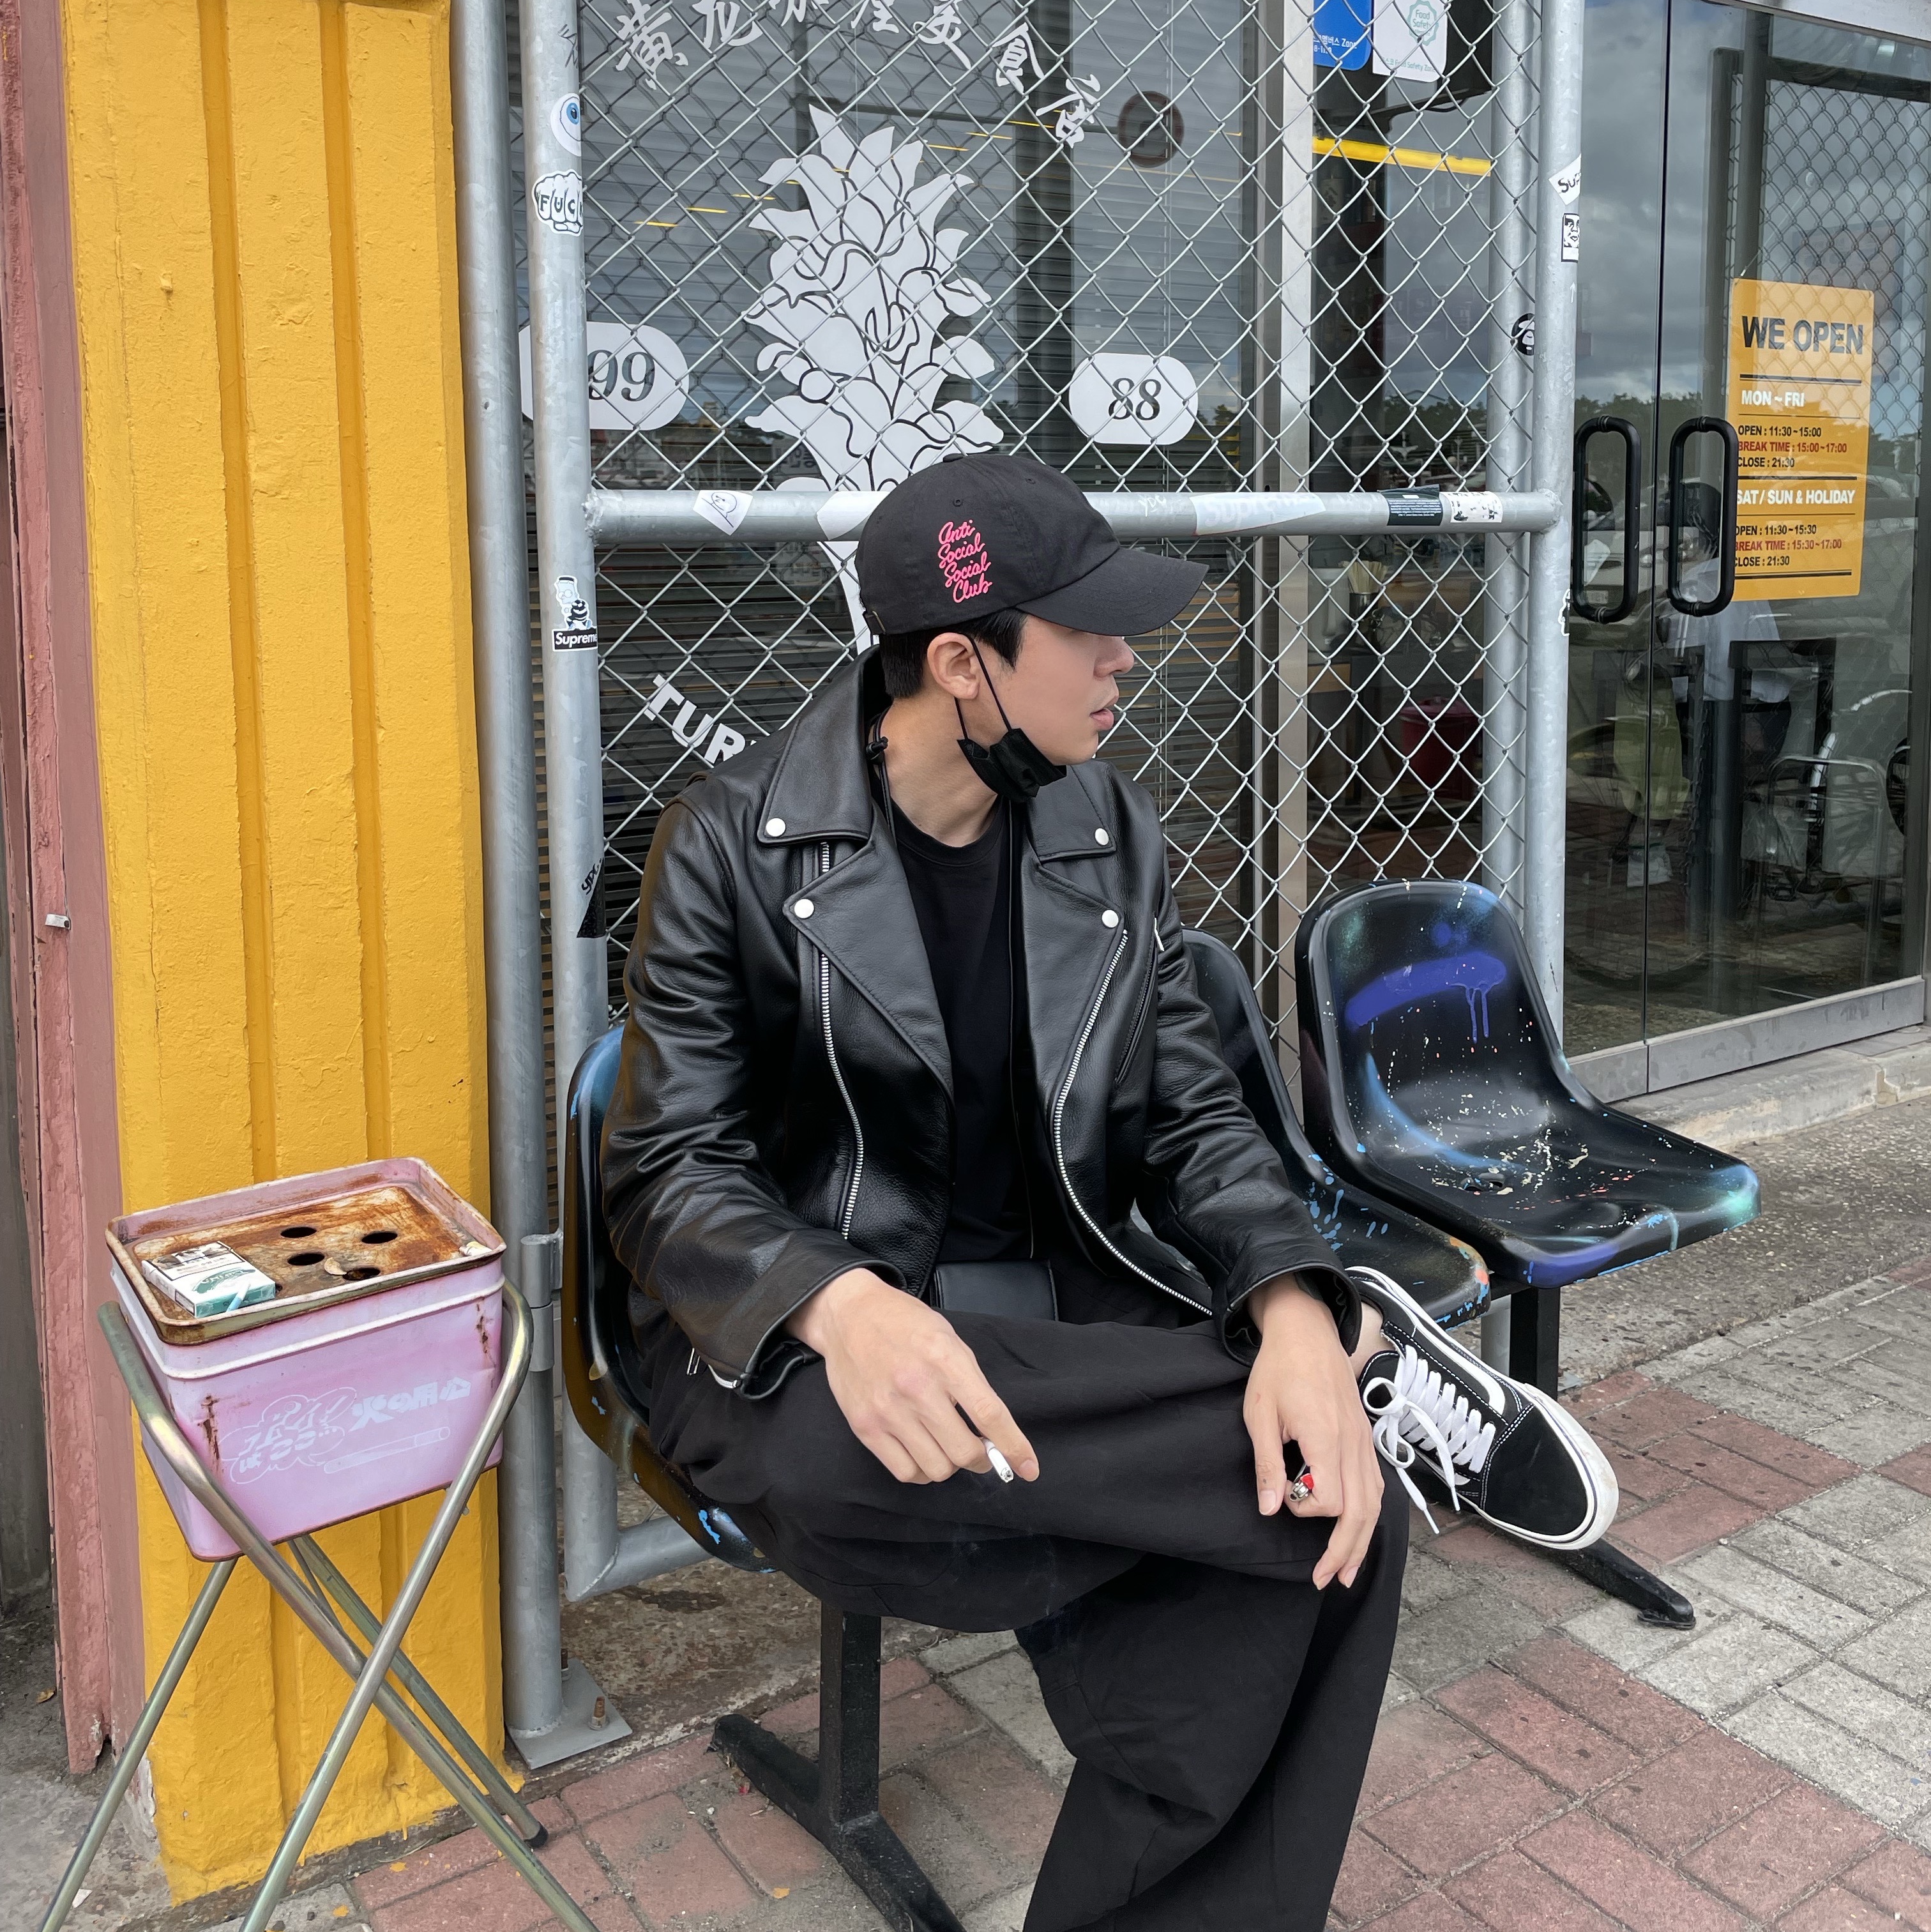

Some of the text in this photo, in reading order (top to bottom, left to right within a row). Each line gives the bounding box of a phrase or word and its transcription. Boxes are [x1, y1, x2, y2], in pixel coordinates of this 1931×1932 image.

[1415, 9, 1430, 20] Food
[1407, 61, 1423, 72] Safety
[1741, 316, 1864, 355] WE OPEN
[588, 349, 656, 401] 99
[1108, 377, 1162, 421] 88
[1741, 390, 1772, 406] MON
[1785, 391, 1805, 407] FRI
[1738, 425, 1762, 436] OPEN
[1738, 441, 1768, 452] BREAK
[1770, 441, 1791, 452] TIME
[1738, 457, 1766, 468] CLOSE
[1771, 457, 1795, 468] 21:30
[1737, 489, 1760, 505] SAT
[1768, 489, 1793, 505] SUN
[1806, 489, 1856, 505] HOLIDAY
[938, 519, 976, 545] Anti
[1735, 525, 1757, 535] OPEN
[937, 532, 986, 569] Social
[1765, 540, 1786, 551] TIME
[944, 551, 992, 588] Social
[1767, 556, 1790, 567] 21:30
[953, 572, 994, 604] Club
[555, 632, 598, 648] Supreme
